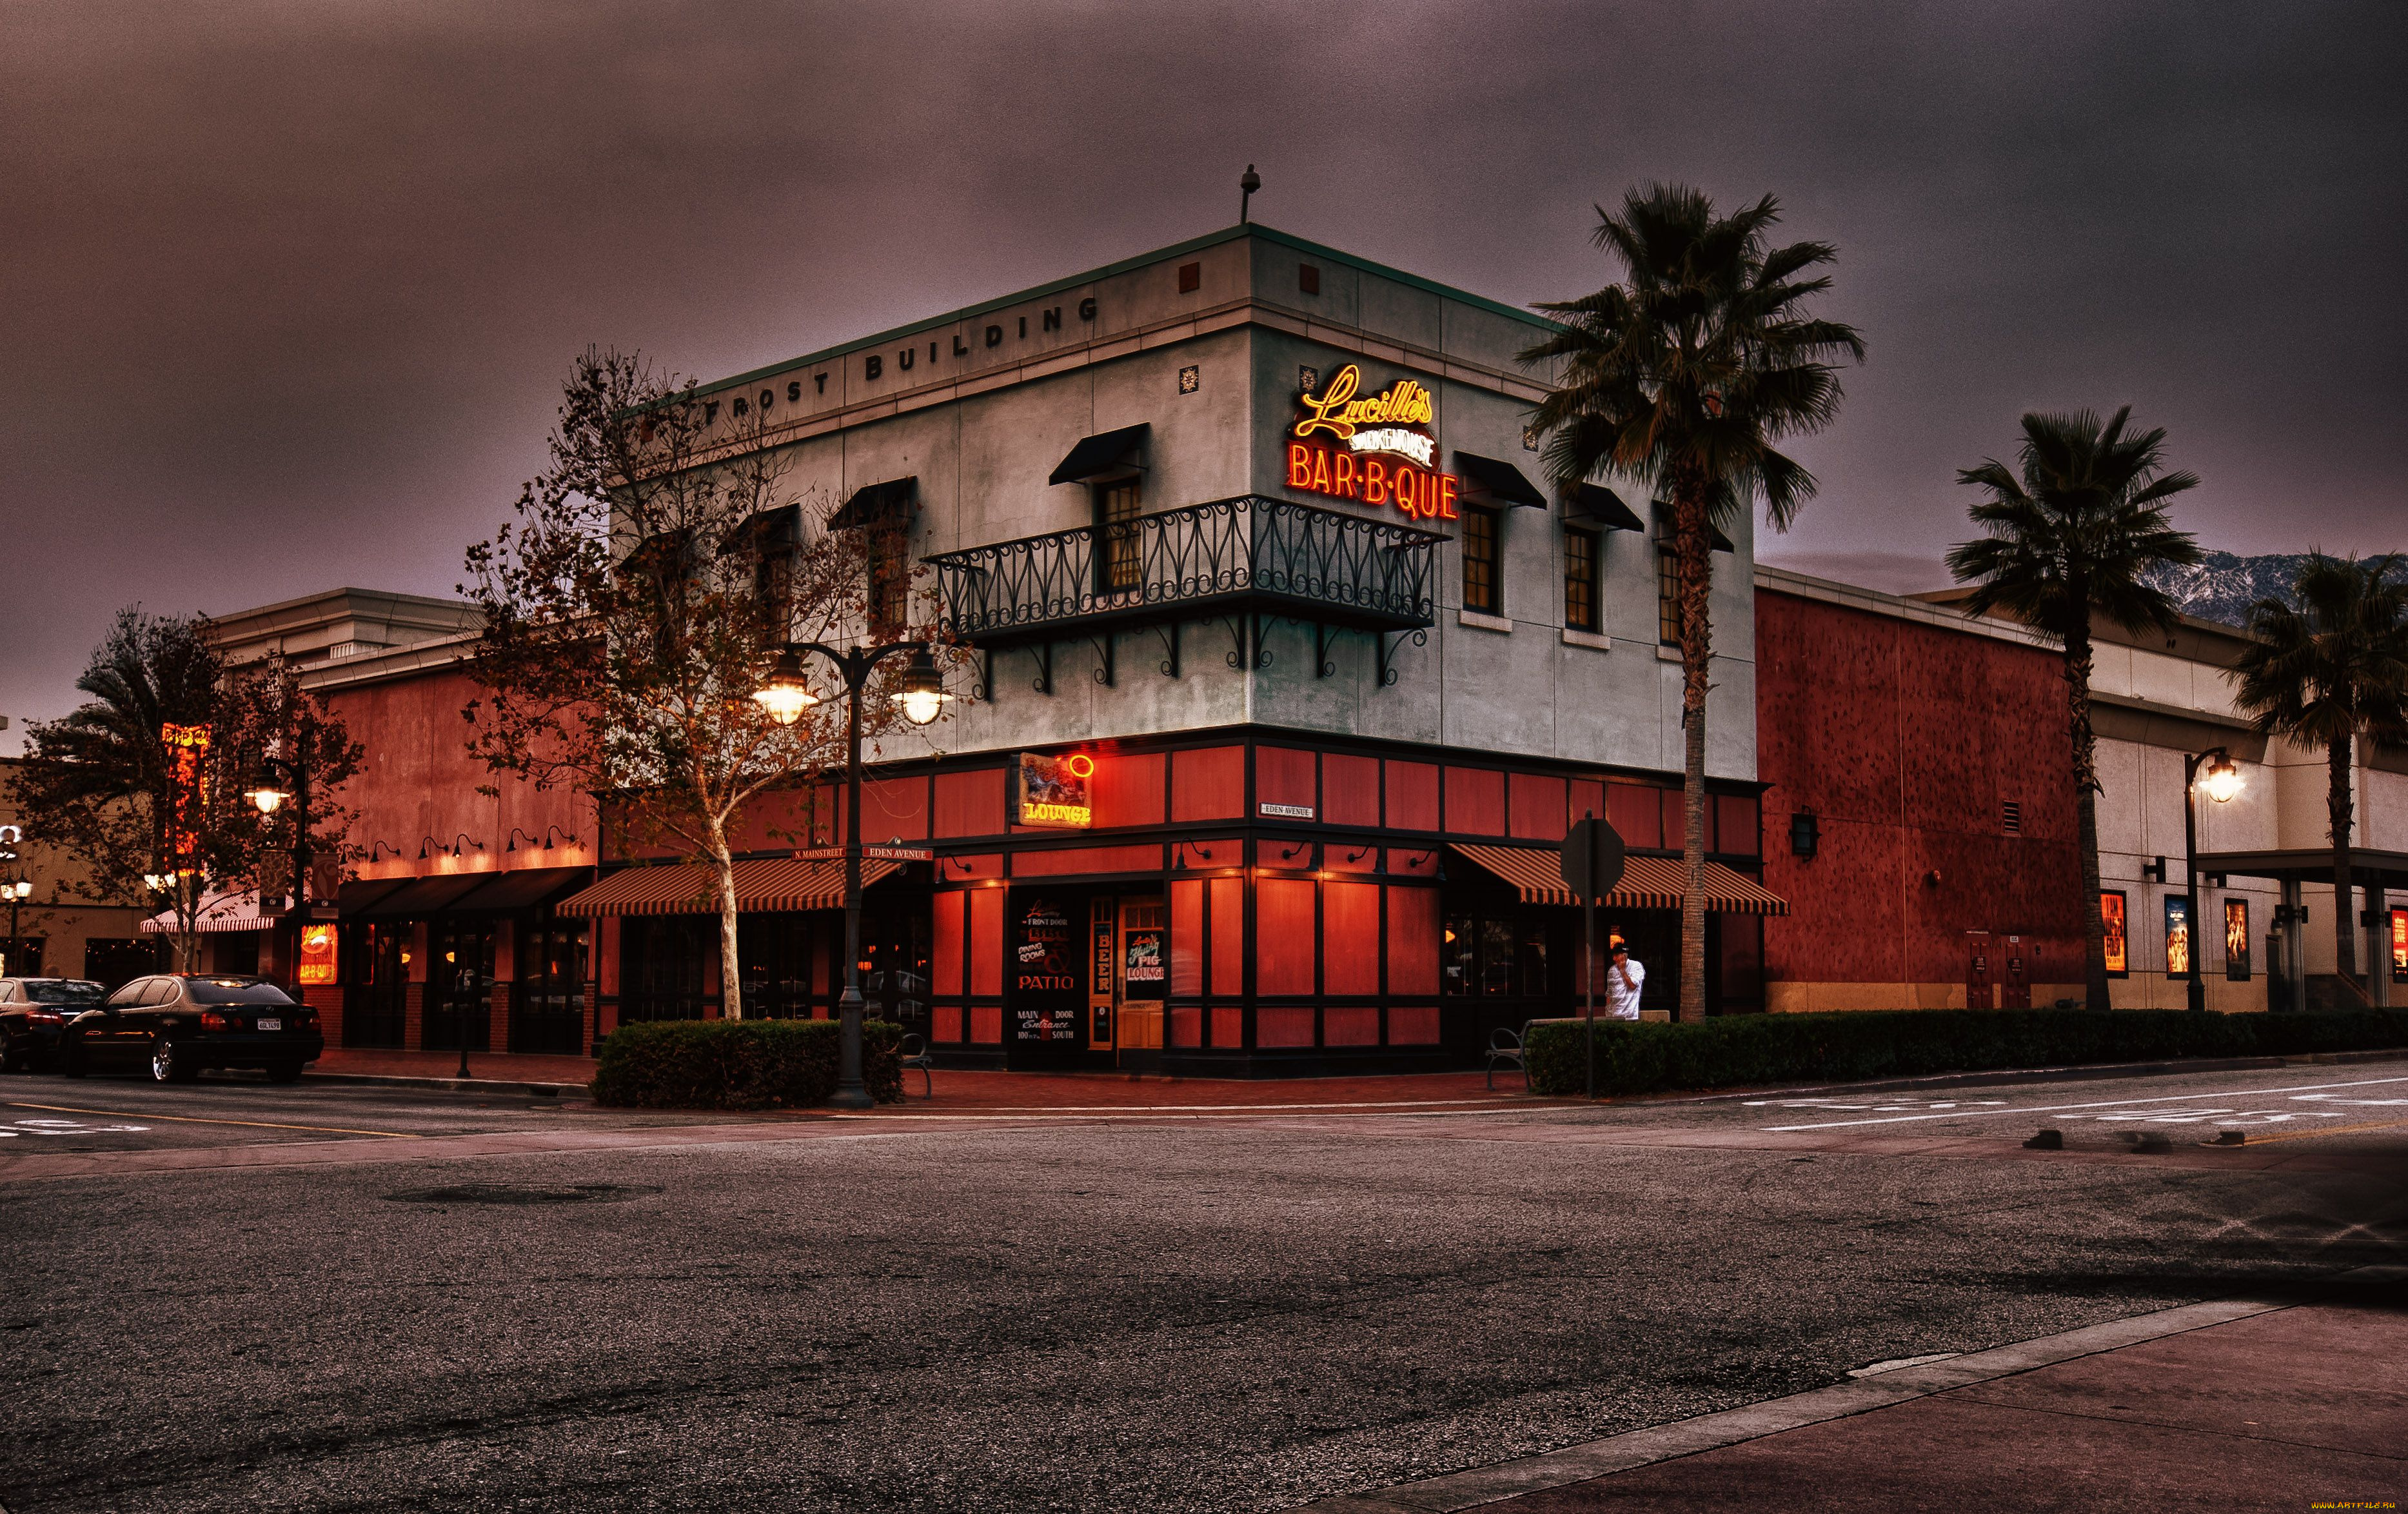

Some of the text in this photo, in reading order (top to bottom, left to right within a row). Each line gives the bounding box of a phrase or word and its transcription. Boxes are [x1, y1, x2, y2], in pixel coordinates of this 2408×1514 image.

[706, 297, 1098, 426] FROST BUILDING
[1023, 802, 1091, 822] LOUNGE
[1265, 805, 1309, 816] EDEN AVENUE
[870, 848, 926, 859] EDEN AVENUE
[1018, 942, 1042, 954] DINING
[1020, 949, 1046, 962] ROOMS
[1138, 955, 1160, 966] PIG
[1098, 935, 1110, 991] BEER
[1018, 975, 1074, 990] PATIO
[1017, 1010, 1074, 1019] MAIN DOOR
[1022, 1018, 1069, 1028] Entrance
[1052, 1030, 1073, 1039] SOUTH
